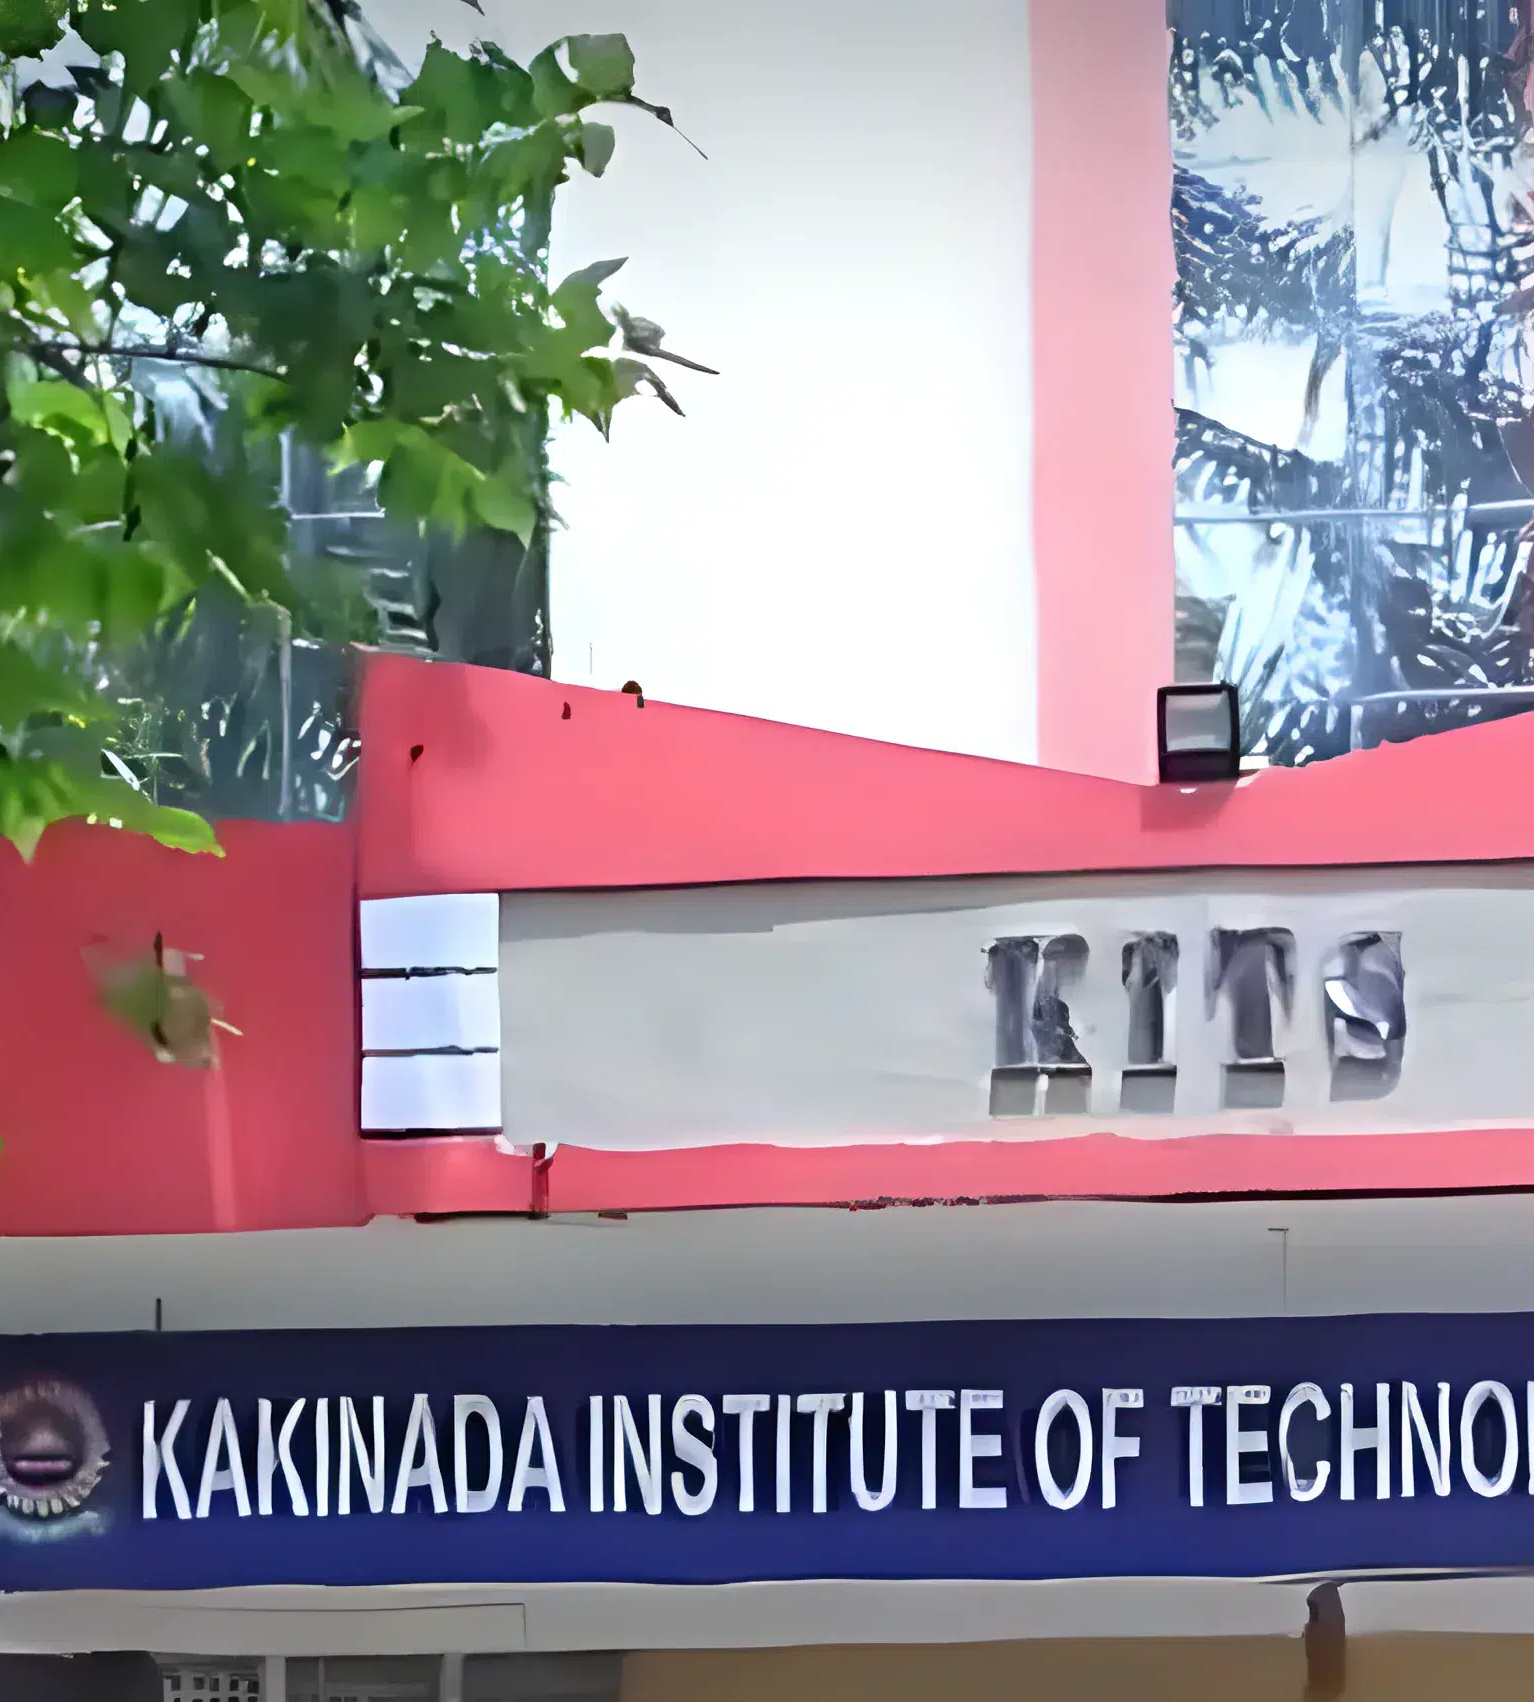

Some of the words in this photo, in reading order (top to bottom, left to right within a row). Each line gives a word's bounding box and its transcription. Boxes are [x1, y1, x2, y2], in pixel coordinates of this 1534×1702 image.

[983, 927, 1406, 1116] KITS
[142, 1393, 566, 1520] KAKINADA
[589, 1389, 1009, 1516] INSTITUTE
[1034, 1387, 1146, 1511] OF
